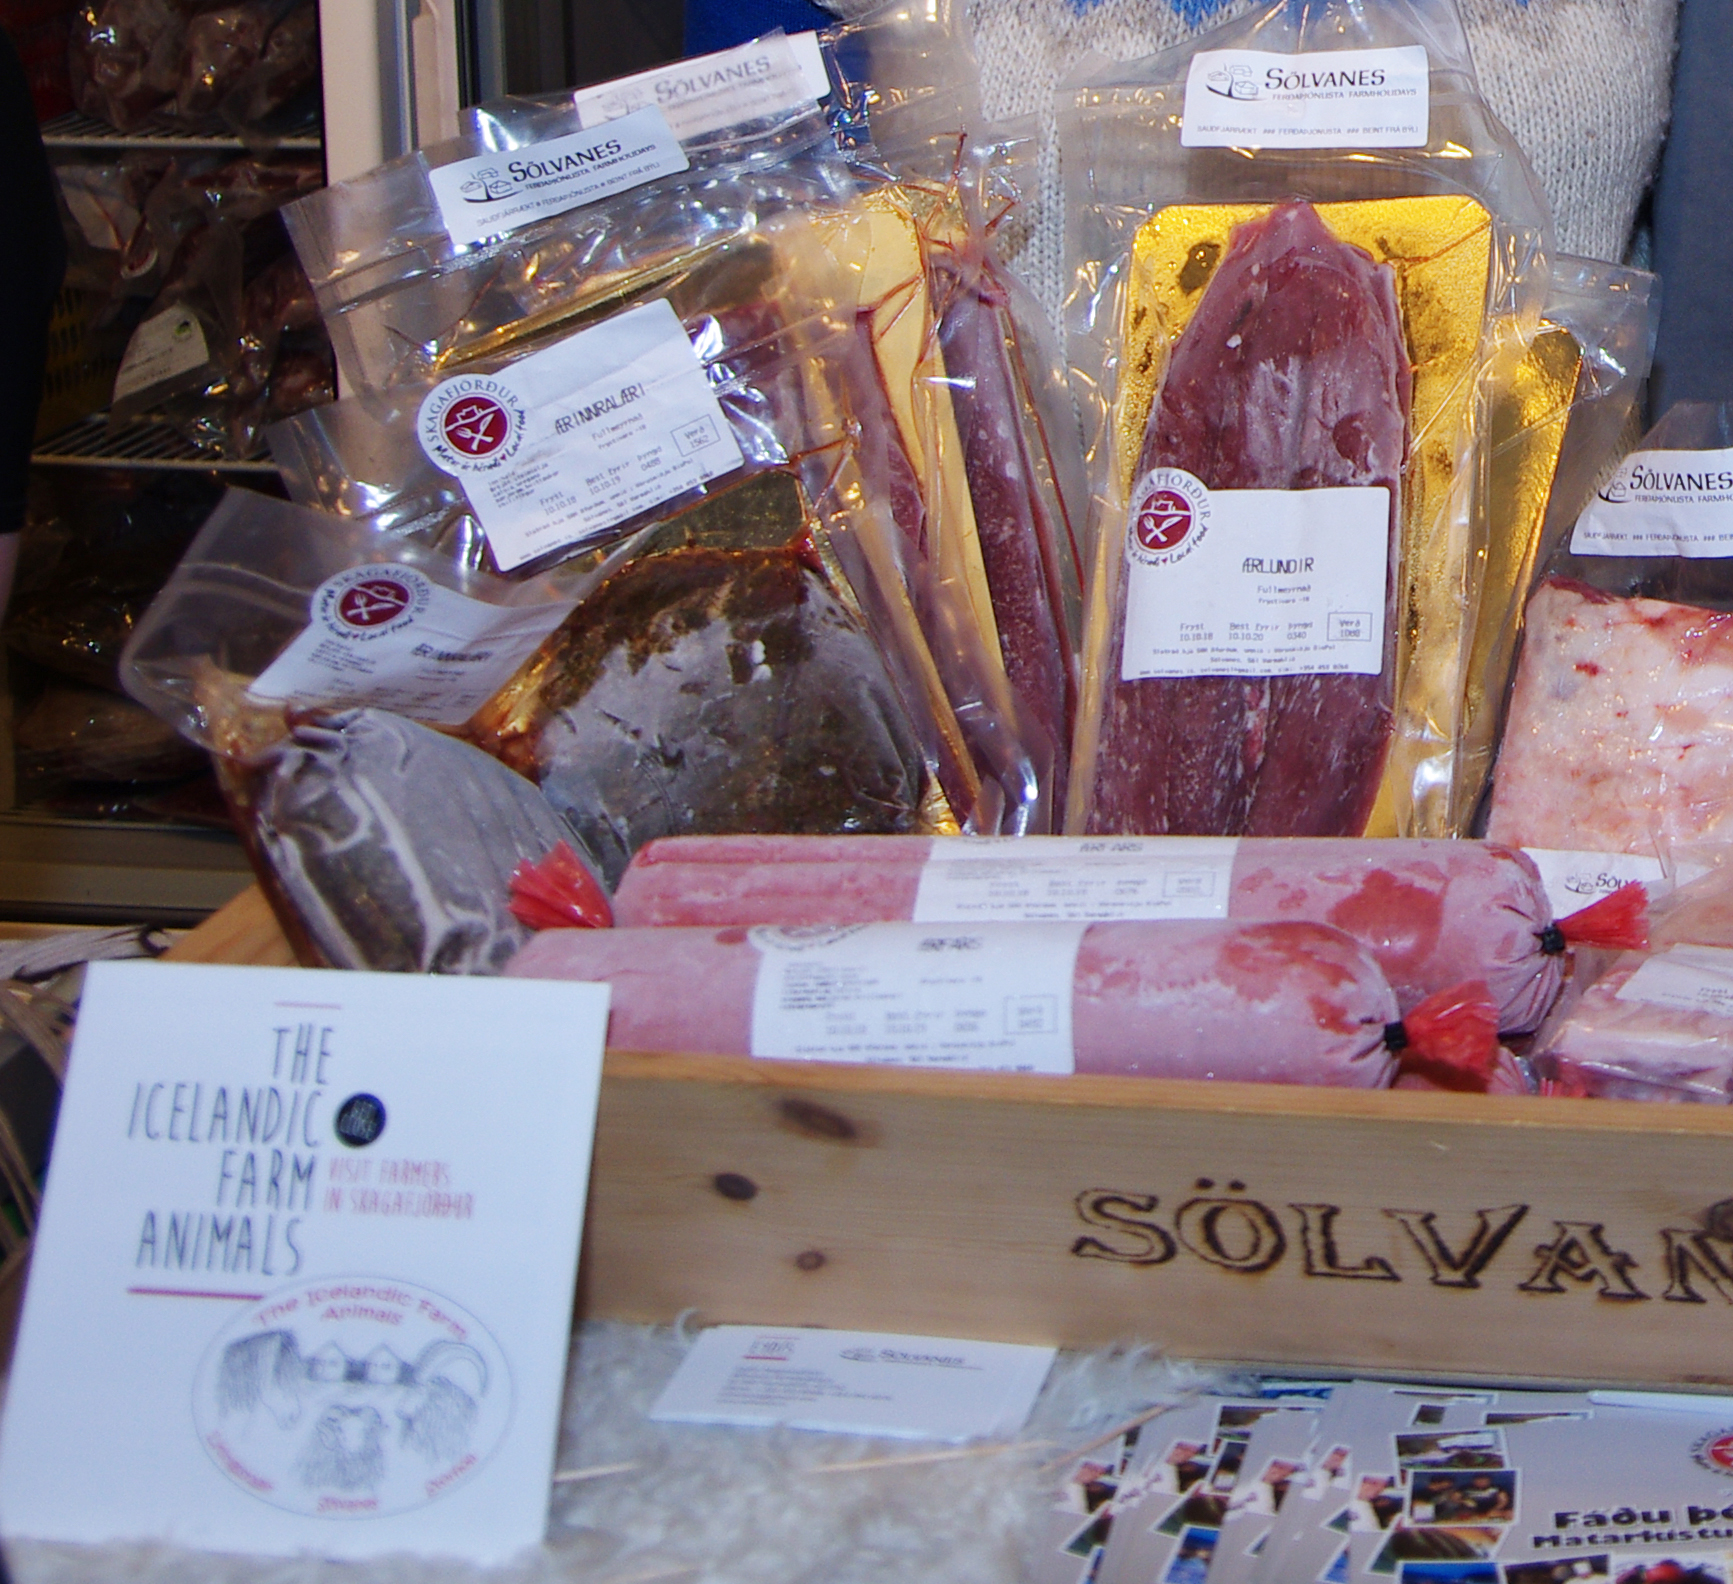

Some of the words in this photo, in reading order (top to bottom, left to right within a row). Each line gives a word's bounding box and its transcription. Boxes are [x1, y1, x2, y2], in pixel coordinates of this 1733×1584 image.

[655, 55, 771, 104] SÖLVANES
[1264, 67, 1386, 91] SÖLVANES
[1348, 88, 1418, 99] FARMHOLIDAYS
[508, 138, 622, 184] SÖLVANES
[593, 144, 657, 173] FARMHOLIDAYS
[1241, 557, 1315, 574] ÆRLUNDIR
[1179, 622, 1205, 632] Fryst
[1229, 622, 1250, 631] Best
[1254, 623, 1280, 632] fyrir
[1339, 619, 1361, 628] Verð
[1179, 632, 1214, 642] 10.10.18
[1228, 632, 1264, 642] 10.10.20
[272, 1023, 335, 1085] THE
[127, 1081, 323, 1149] ICELANDIC
[215, 1149, 317, 1211] FARM
[329, 1156, 374, 1183] VISIT
[380, 1158, 451, 1189] FARMERS
[322, 1186, 343, 1213] IN
[135, 1211, 305, 1276] ANIMALS
[253, 1298, 299, 1326] The
[307, 1284, 414, 1308] Icelandic
[417, 1298, 468, 1342] Farm
[321, 1305, 403, 1326] Animals
[1553, 1502, 1671, 1529] Fáðu
